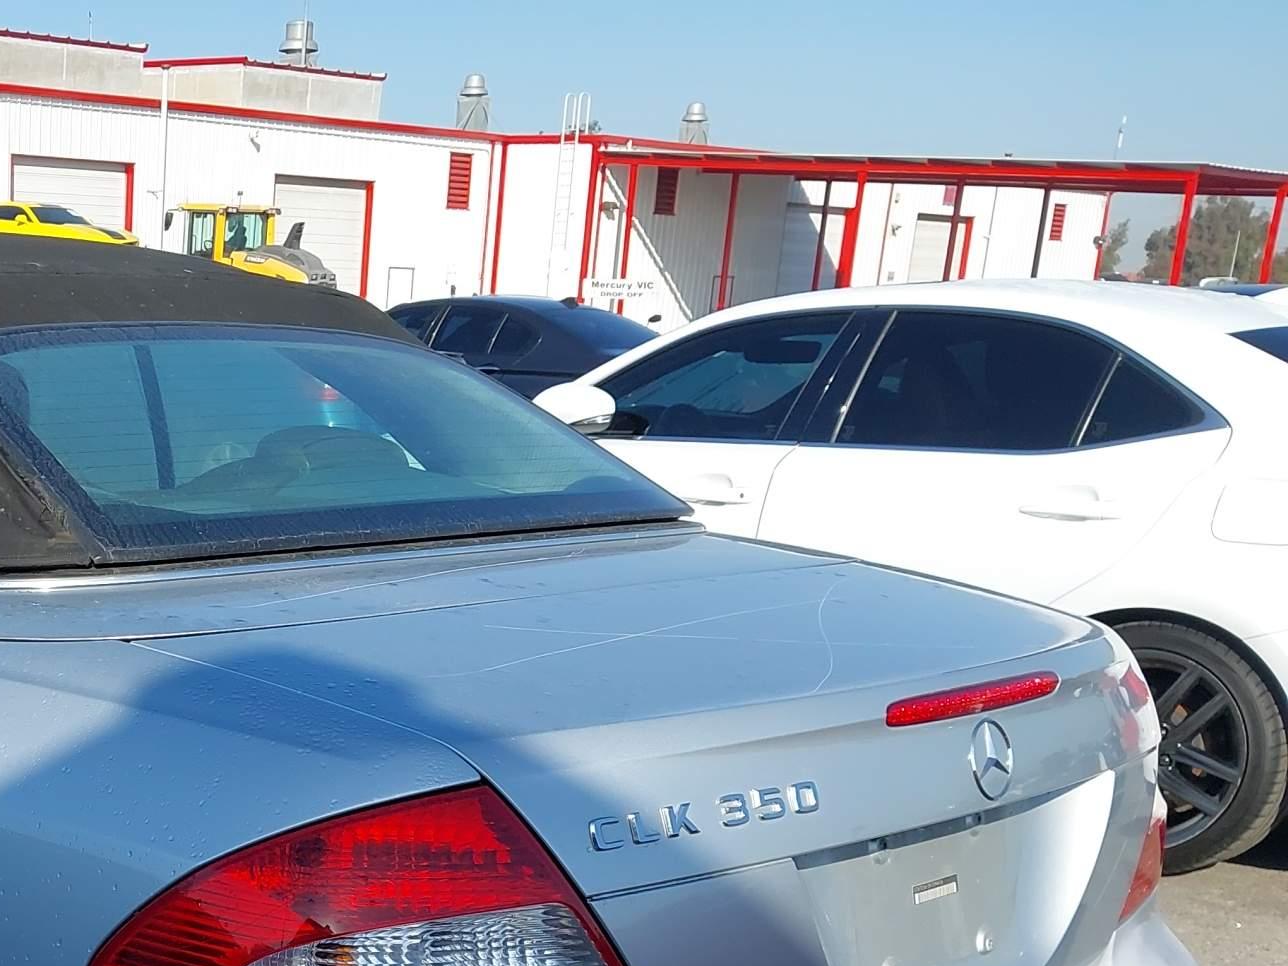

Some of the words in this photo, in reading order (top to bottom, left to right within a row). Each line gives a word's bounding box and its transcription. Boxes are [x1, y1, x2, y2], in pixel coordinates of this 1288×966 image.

[591, 281, 633, 290] Mercury
[637, 281, 654, 289] VIC
[588, 801, 701, 851] CLK
[716, 780, 819, 827] 350
